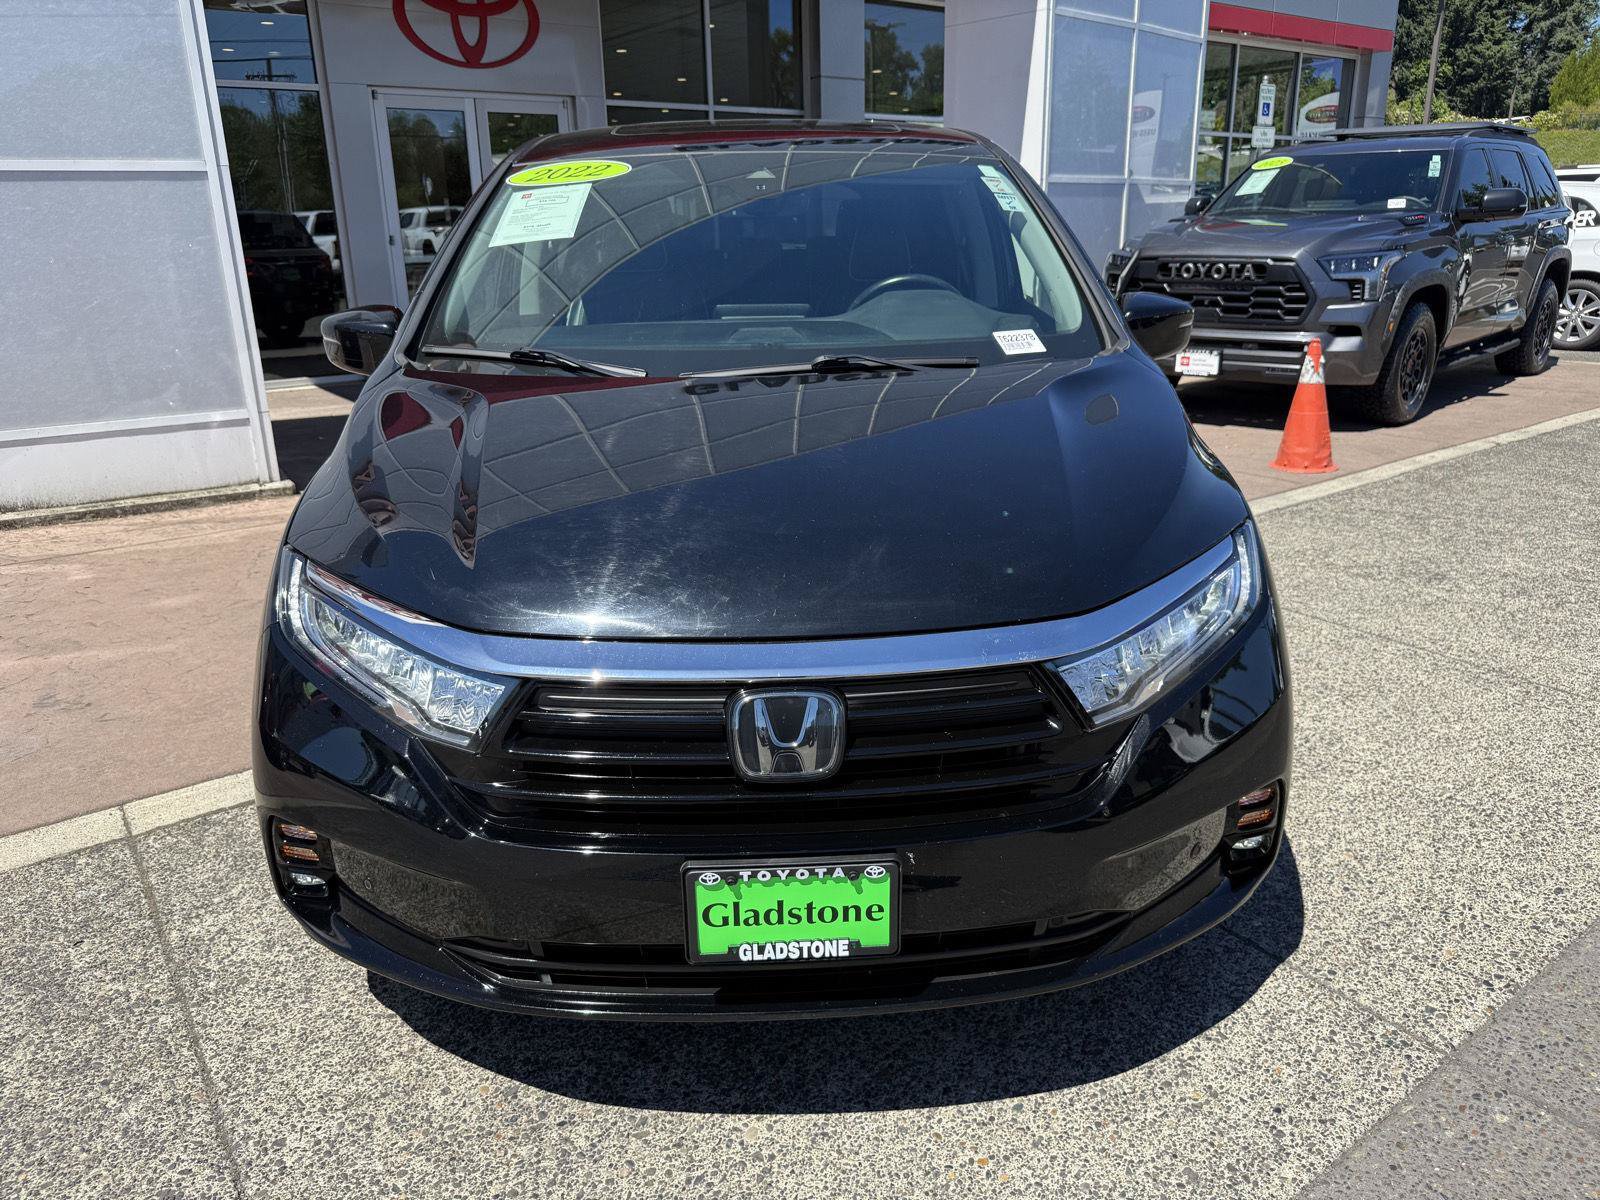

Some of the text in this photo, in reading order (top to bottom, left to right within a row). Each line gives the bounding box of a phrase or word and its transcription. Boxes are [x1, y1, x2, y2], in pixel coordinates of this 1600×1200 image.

[524, 164, 613, 183] 2022
[1168, 262, 1256, 280] TOYOTA
[739, 866, 846, 882] TOYOTA
[701, 899, 885, 928] Gladstone
[738, 939, 850, 962] GLADSTONE
